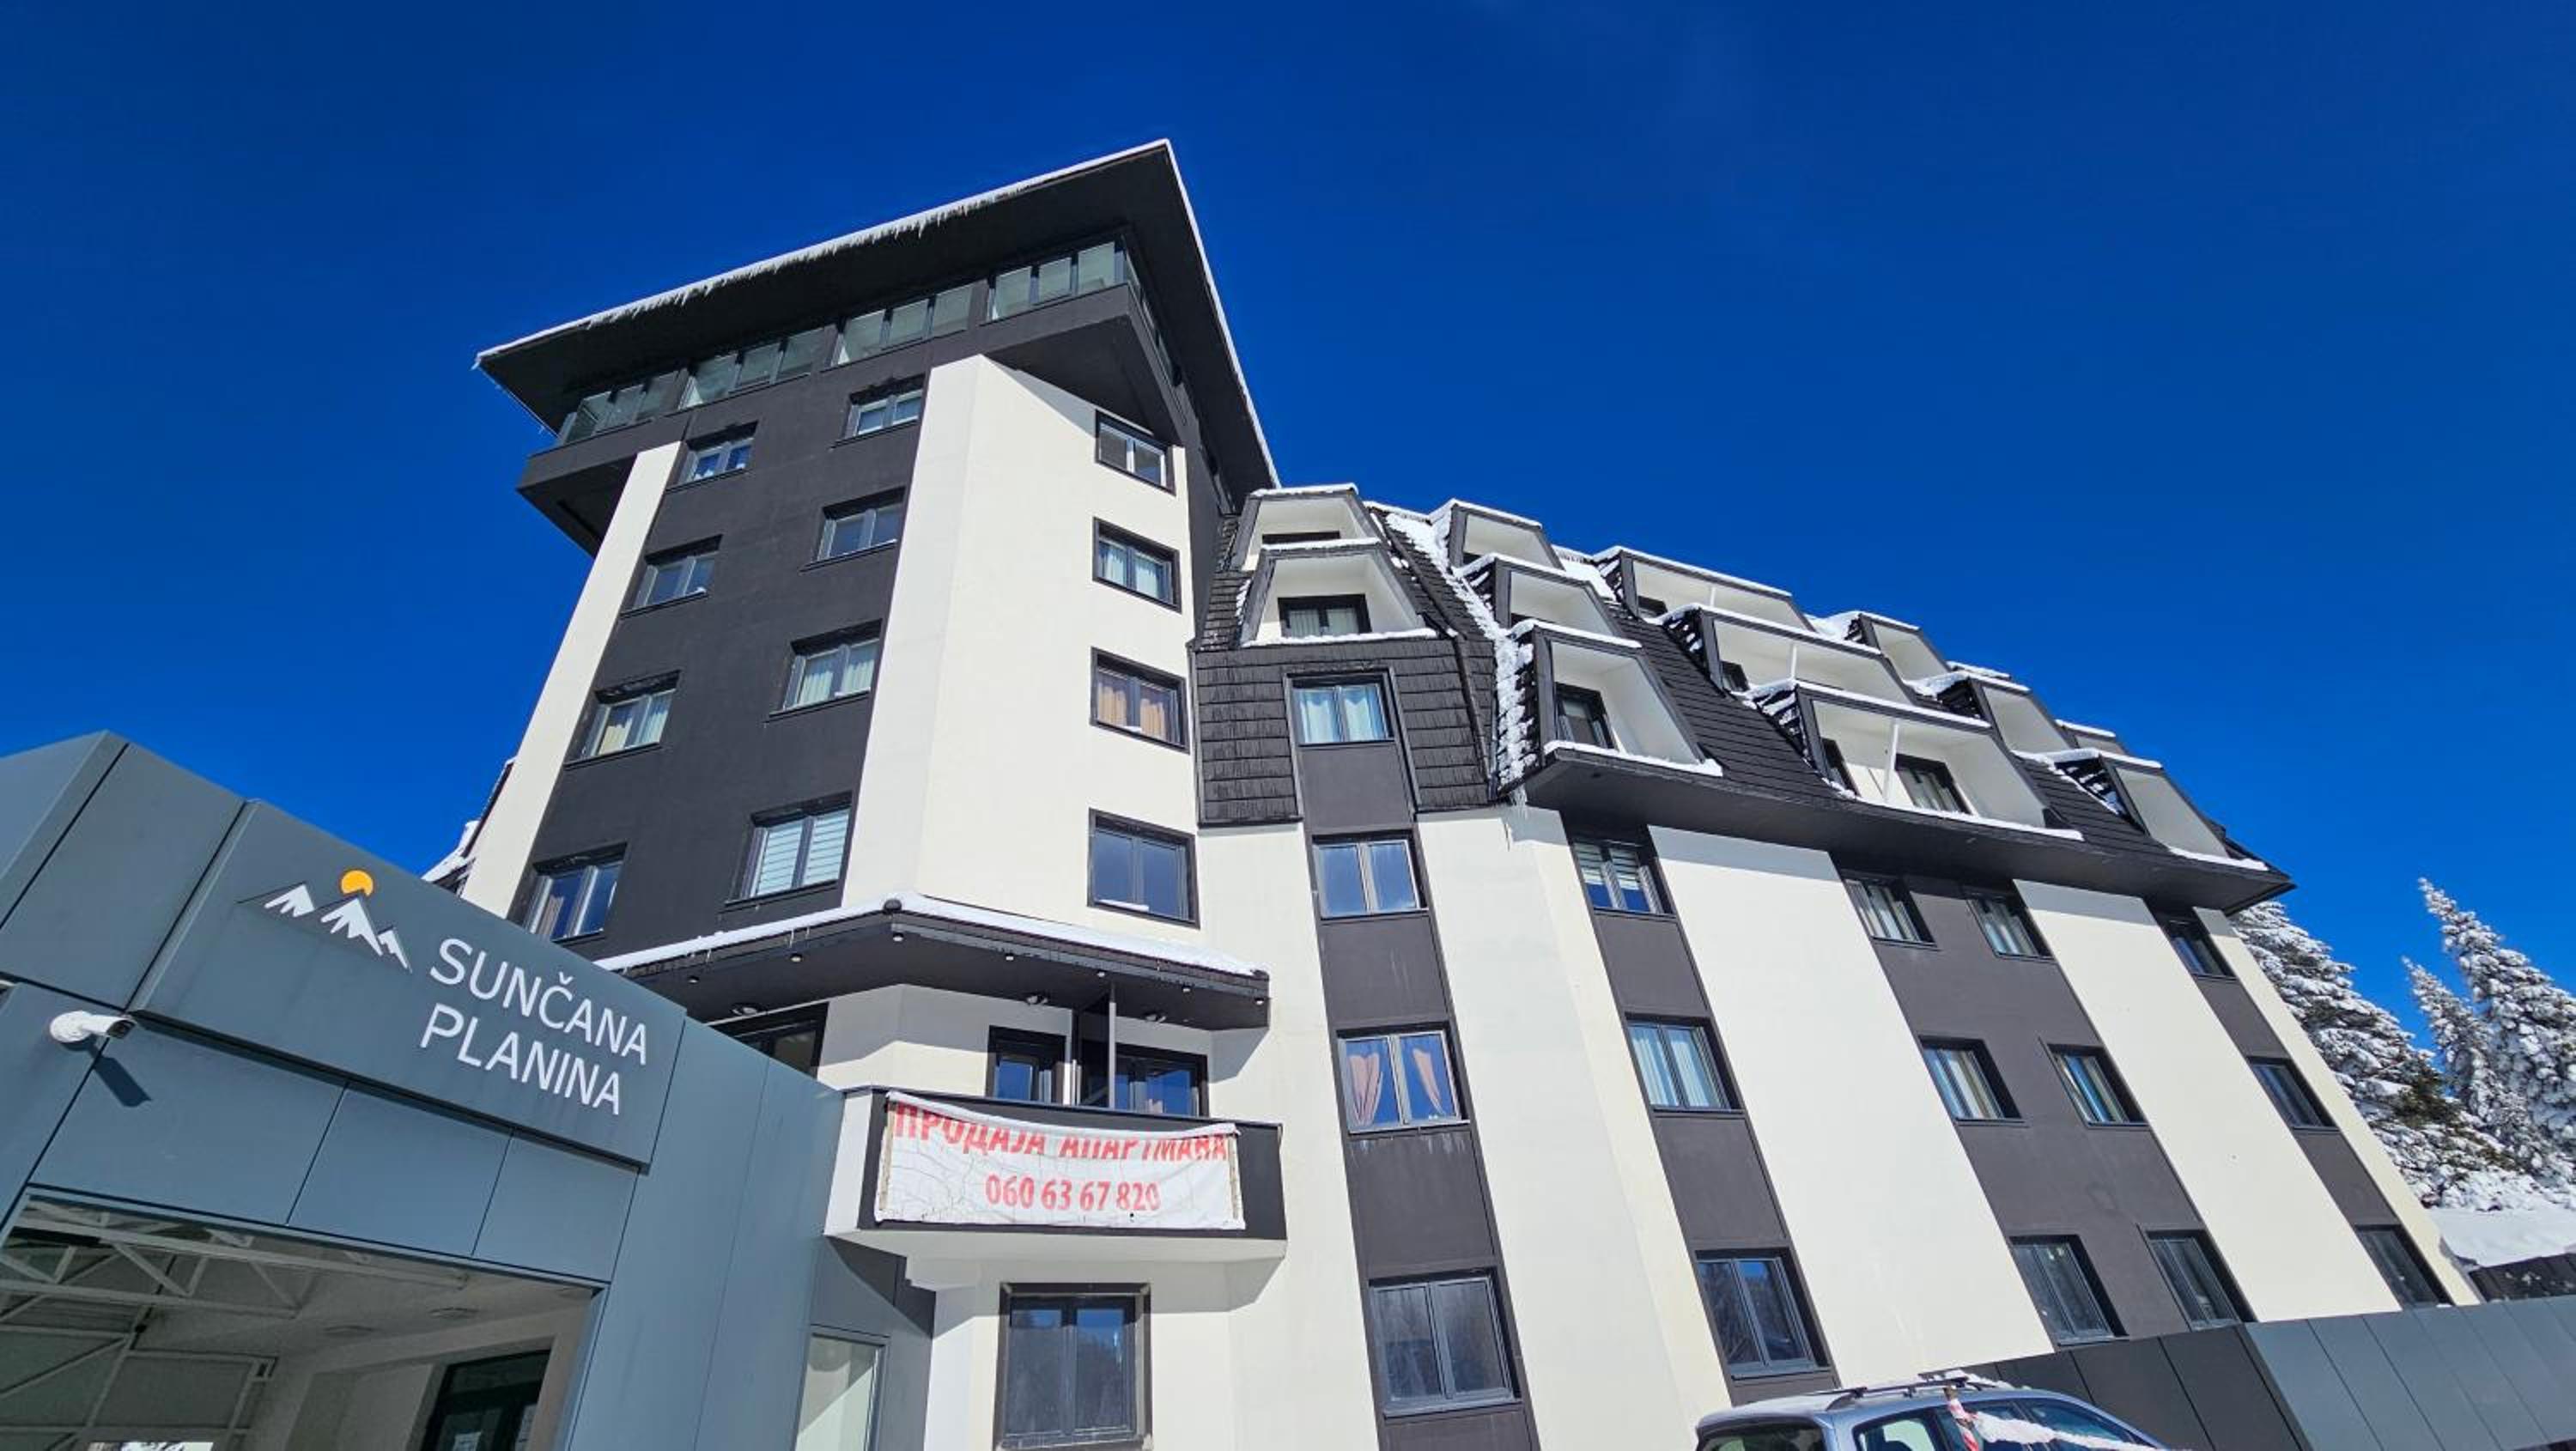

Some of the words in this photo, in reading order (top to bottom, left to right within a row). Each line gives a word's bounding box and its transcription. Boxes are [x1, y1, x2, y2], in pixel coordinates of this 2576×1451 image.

[428, 938, 647, 1065] SUNČANA
[420, 1003, 620, 1115] PLANINA
[895, 1102, 1045, 1155] ПРОДАЈА
[987, 1174, 1035, 1209] 060
[1040, 1179, 1072, 1210] 63
[1078, 1181, 1110, 1211] 67
[1116, 1181, 1160, 1211] 820
